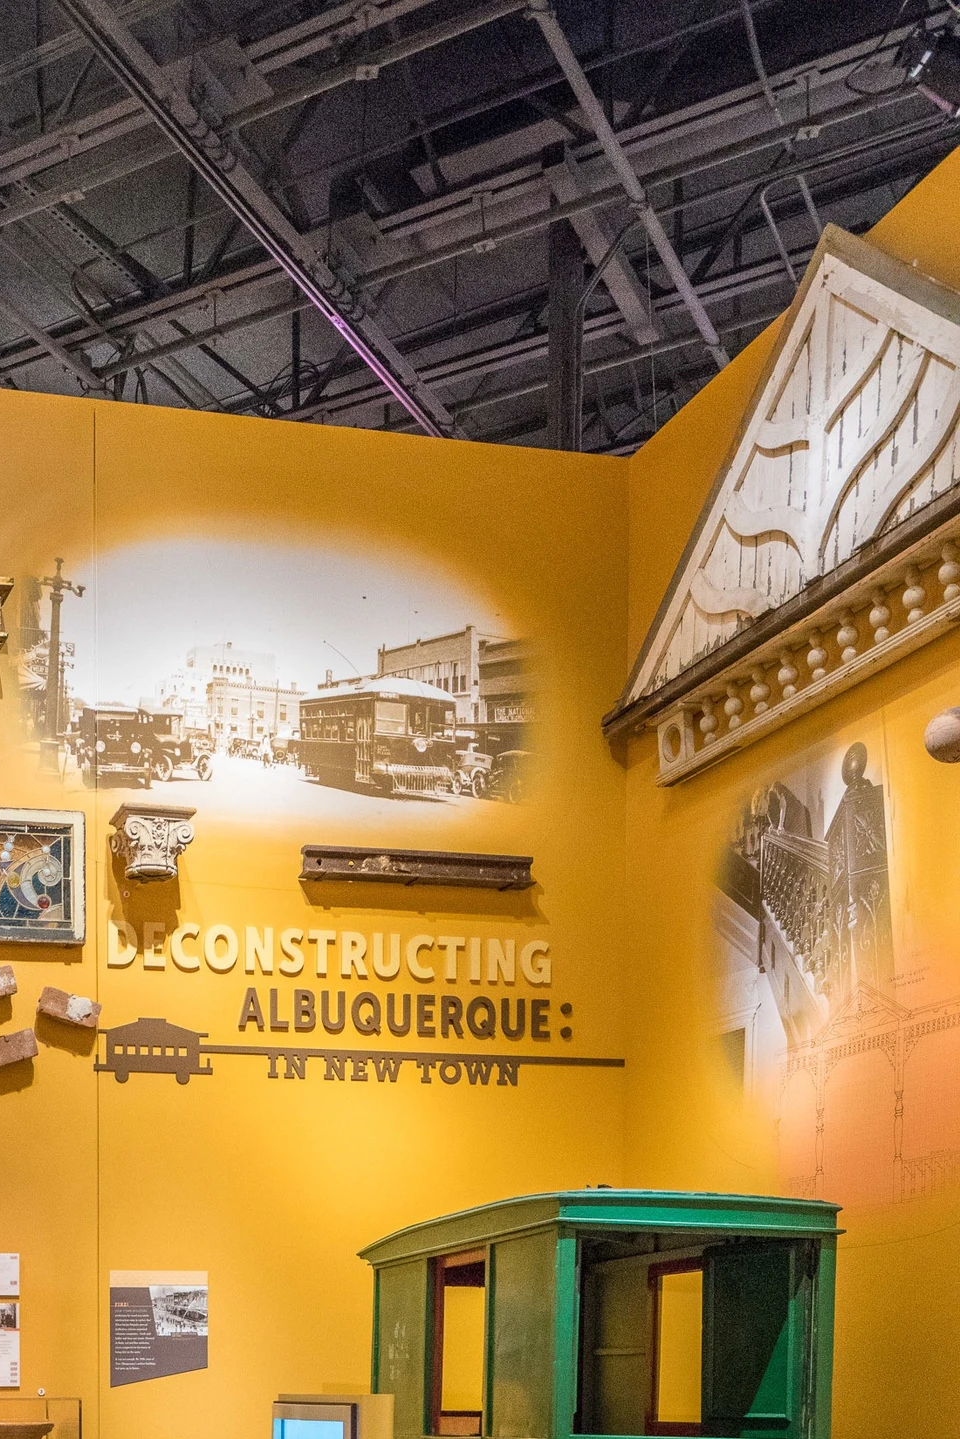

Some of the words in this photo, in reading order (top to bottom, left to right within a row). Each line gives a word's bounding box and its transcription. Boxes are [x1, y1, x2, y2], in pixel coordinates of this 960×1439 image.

[107, 919, 552, 985] DECONSTRUCTING
[238, 987, 573, 1040] ALBUQUERQUE:
[267, 1053, 308, 1080] IN
[323, 1055, 402, 1083] NEW
[416, 1058, 521, 1087] TOWN
